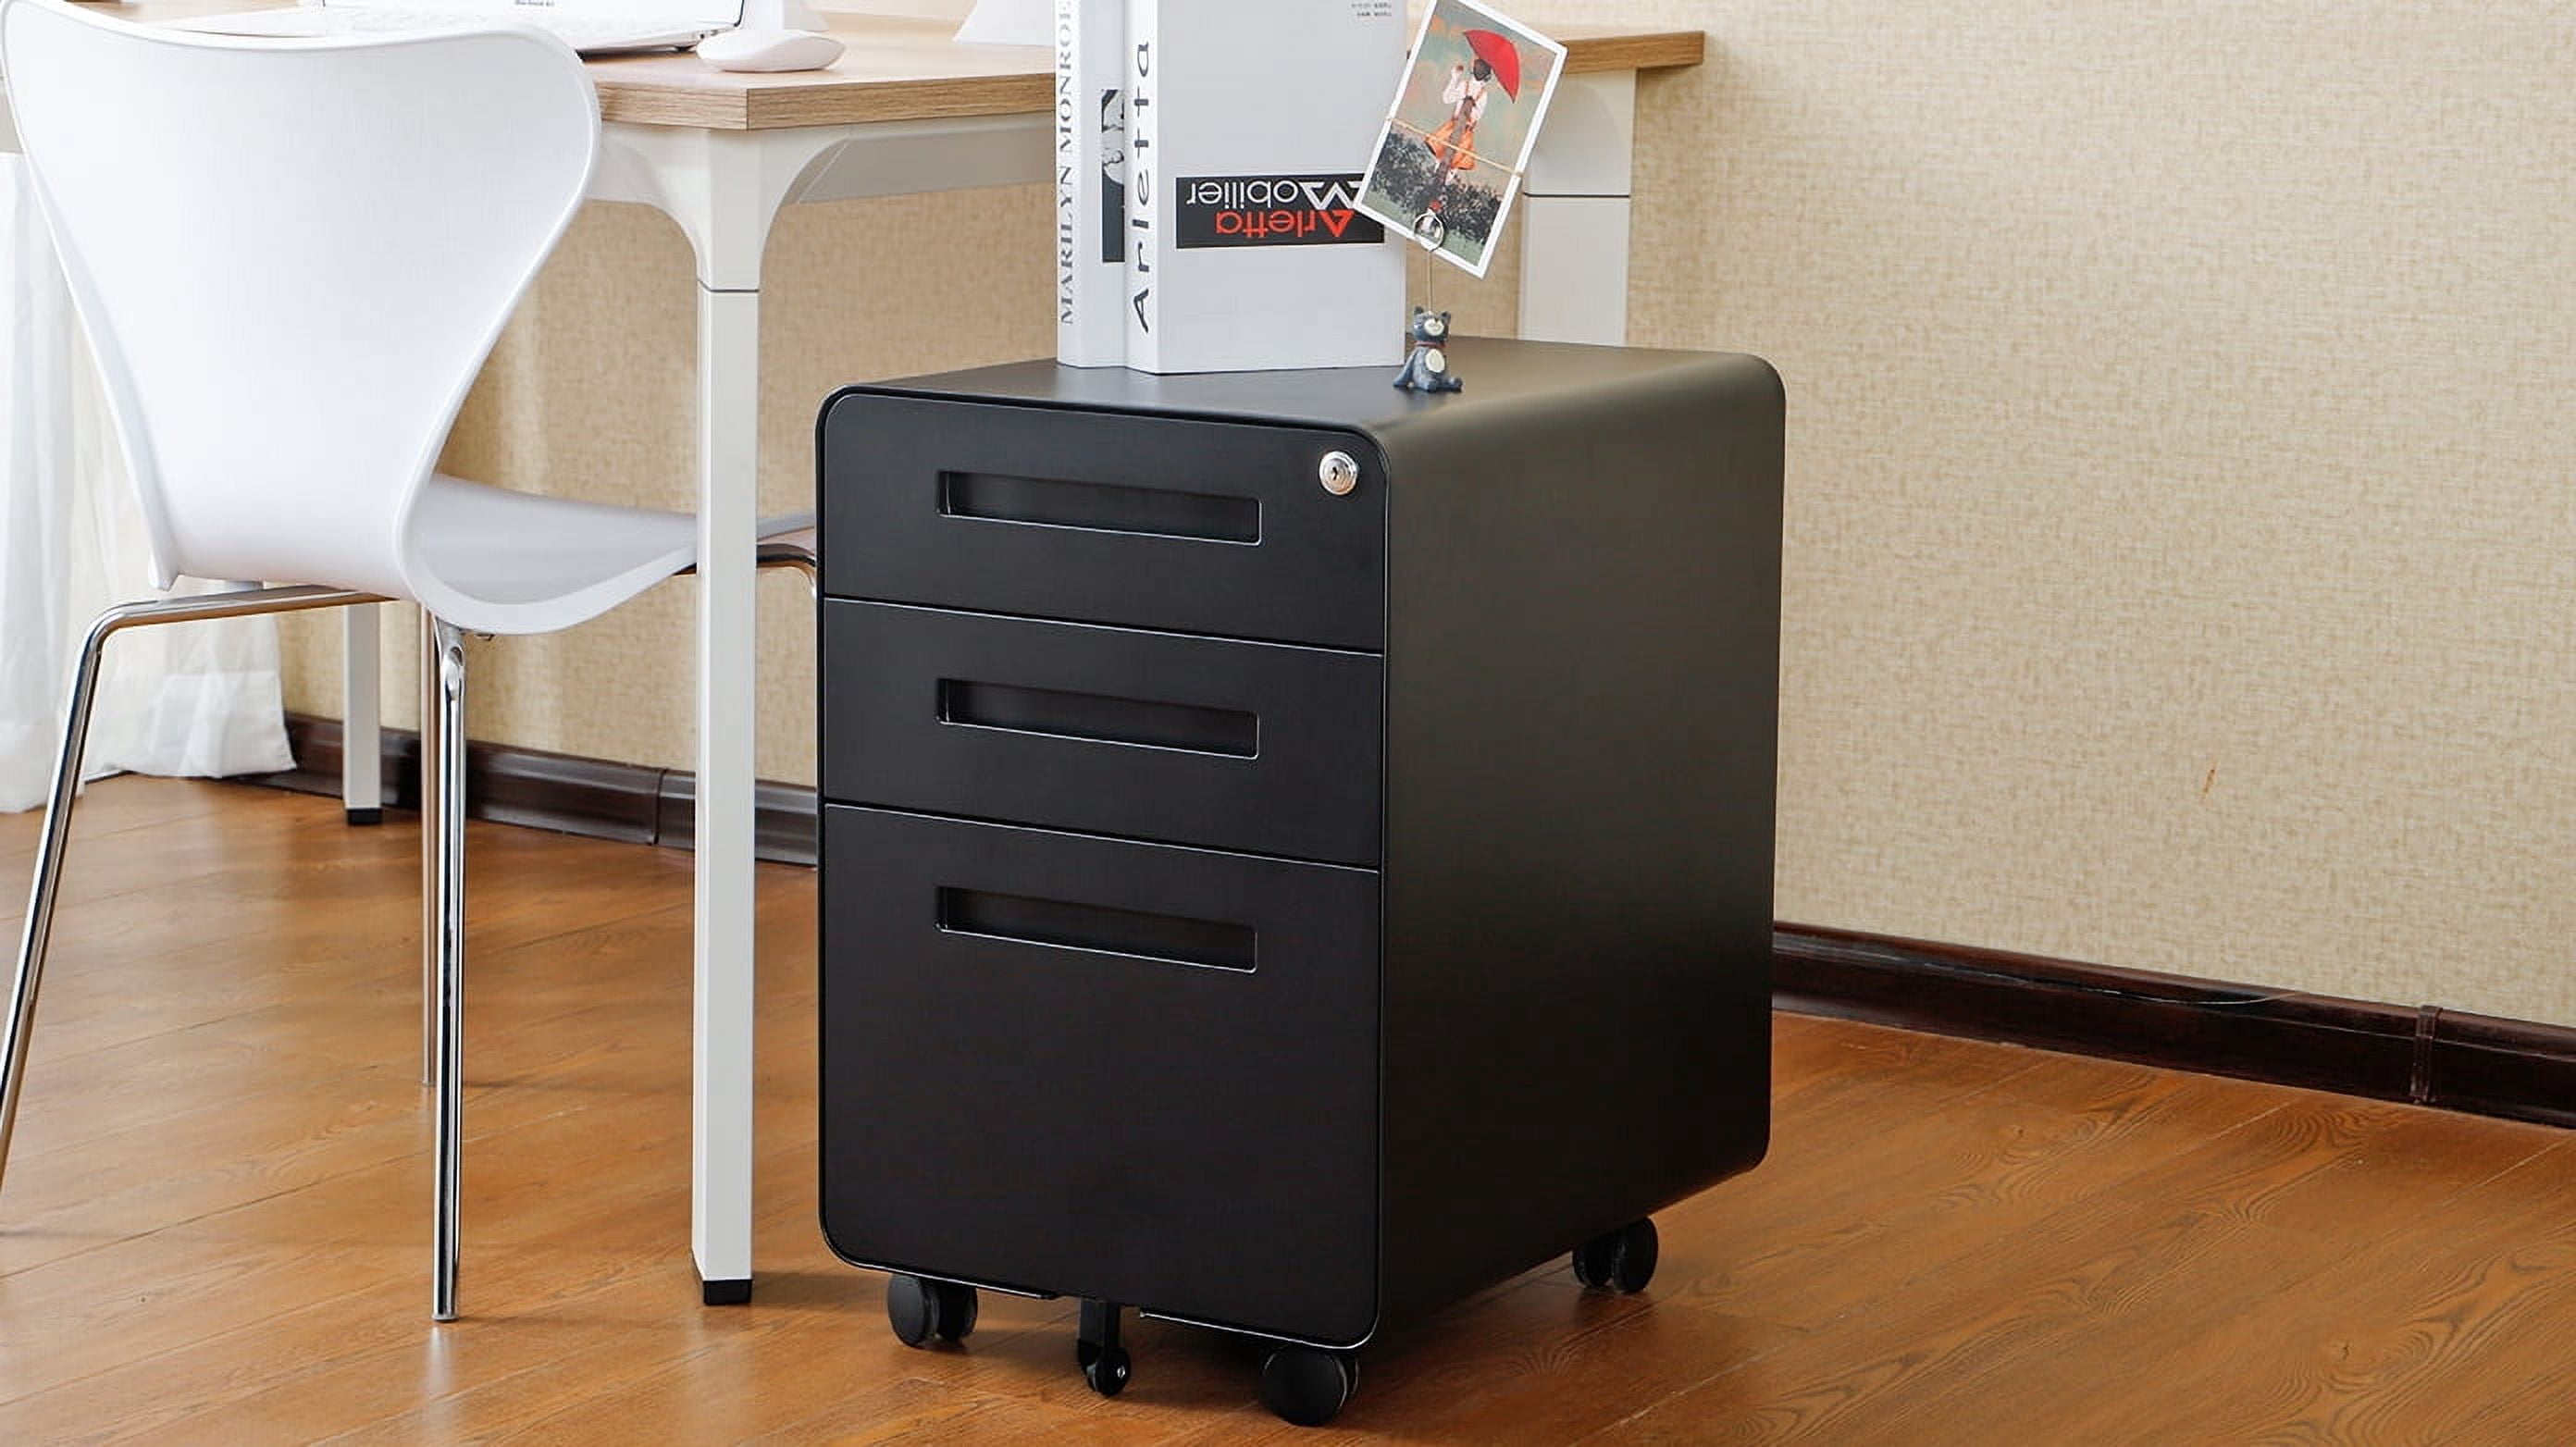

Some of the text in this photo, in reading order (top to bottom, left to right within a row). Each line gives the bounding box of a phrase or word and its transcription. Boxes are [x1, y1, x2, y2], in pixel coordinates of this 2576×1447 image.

[1059, 1, 1073, 325] MARILYN MONROE
[1132, 41, 1150, 334] Arletta
[1186, 179, 1364, 210] Mobilier
[1215, 209, 1355, 238] Arletta
